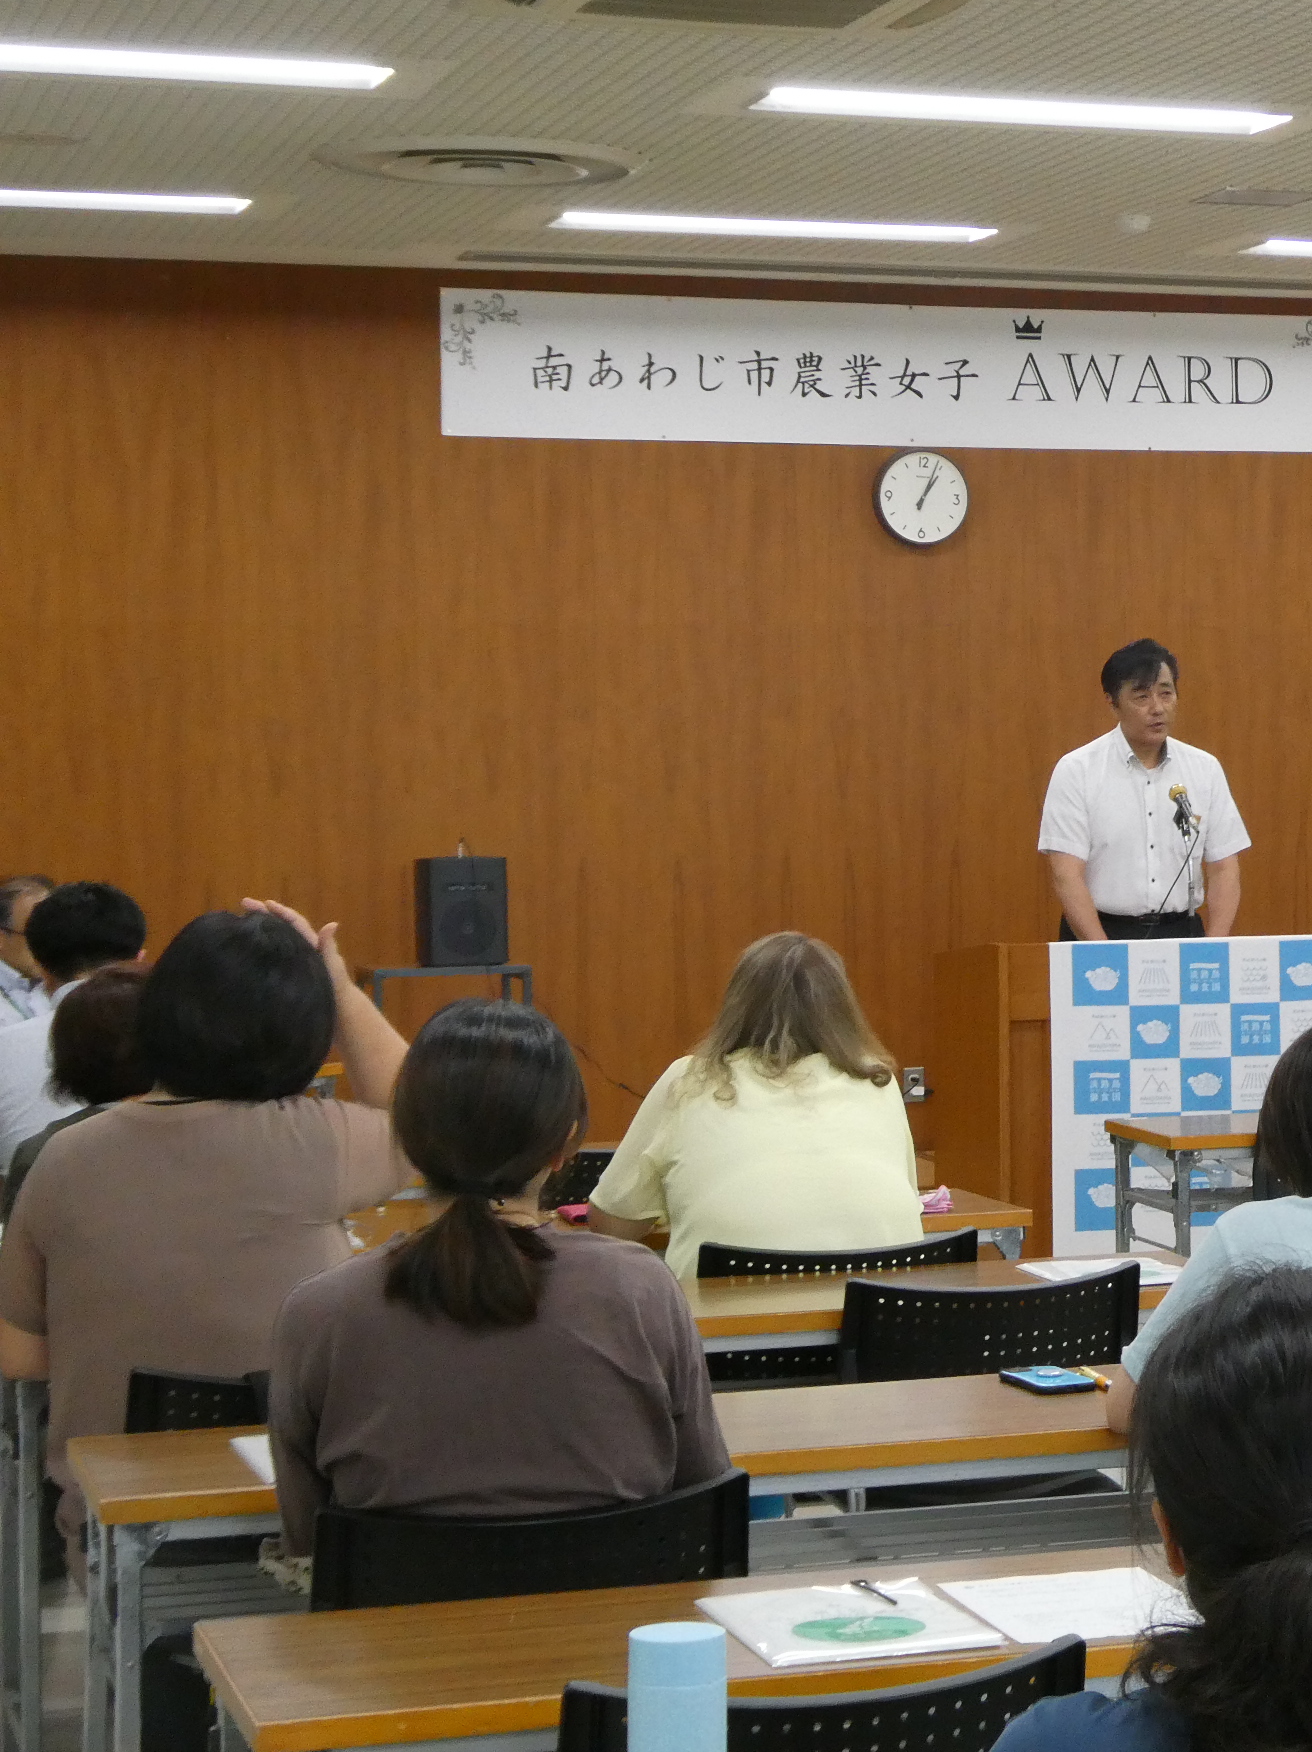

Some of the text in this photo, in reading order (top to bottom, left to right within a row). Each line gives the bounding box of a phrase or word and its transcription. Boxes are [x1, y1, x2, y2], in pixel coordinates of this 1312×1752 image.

[531, 344, 1274, 405] 南あわじ市農業女子 AWARD
[918, 456, 929, 468] 12
[884, 490, 893, 501] 9
[953, 494, 961, 506] 3
[917, 527, 926, 539] 6
